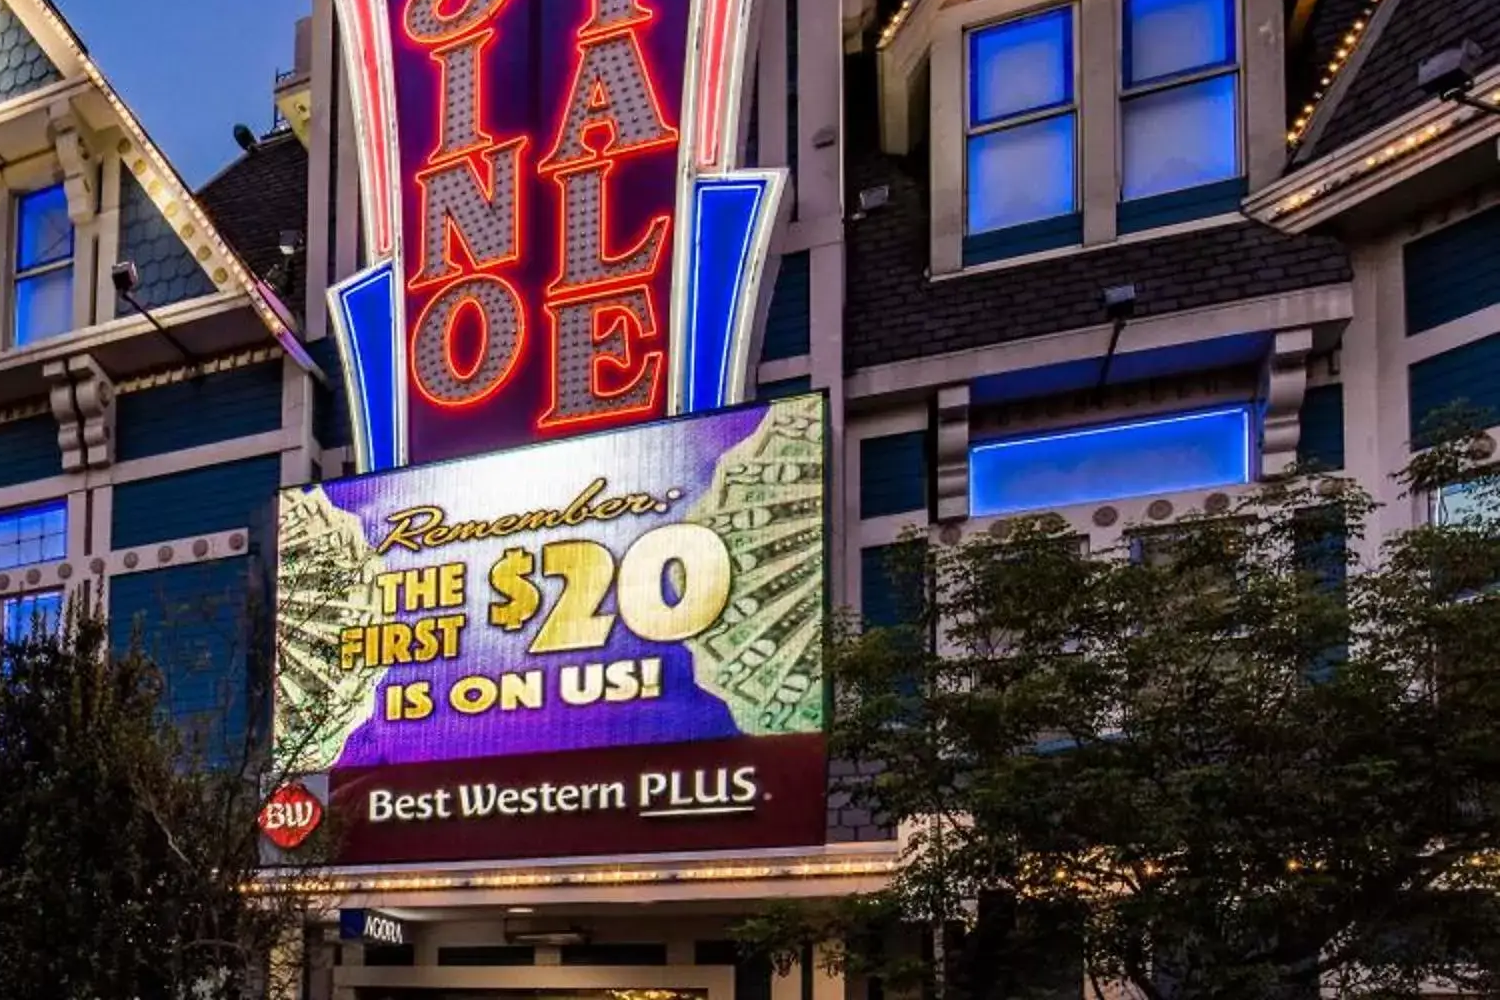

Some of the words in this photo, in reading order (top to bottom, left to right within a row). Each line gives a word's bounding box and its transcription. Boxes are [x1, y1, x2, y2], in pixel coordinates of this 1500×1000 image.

[376, 477, 682, 554] Remember:
[377, 562, 467, 616] THE
[488, 523, 732, 655] $20
[341, 614, 466, 671] FIRST
[385, 681, 434, 722] IS
[449, 671, 543, 714] ON
[560, 657, 662, 706] US!
[265, 801, 314, 829] BW
[368, 788, 451, 822] Best
[459, 781, 626, 816] Western
[638, 766, 758, 807] PLUS
